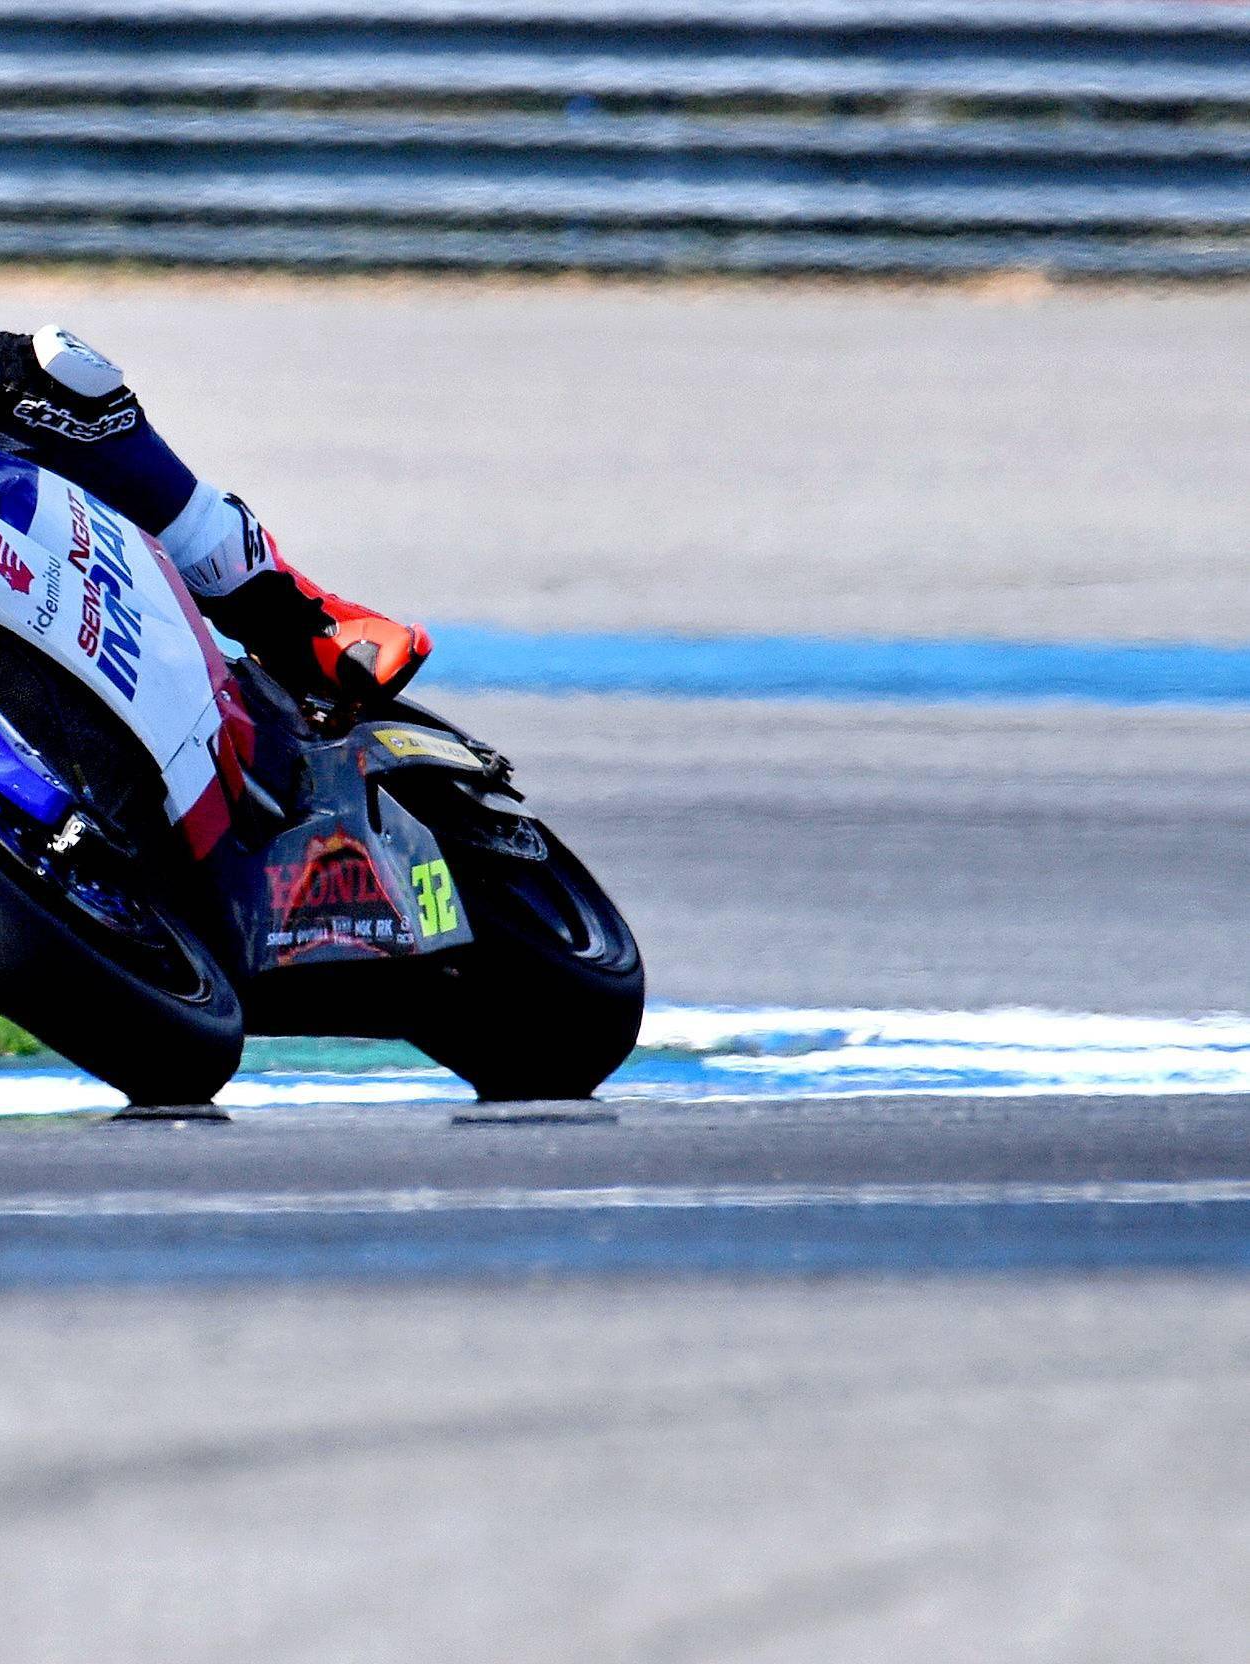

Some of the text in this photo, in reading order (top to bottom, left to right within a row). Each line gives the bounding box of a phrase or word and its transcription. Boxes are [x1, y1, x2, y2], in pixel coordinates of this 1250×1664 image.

[27, 556, 62, 635] idemitsu
[67, 487, 105, 658] SEMNGAT
[412, 859, 458, 938] 32
